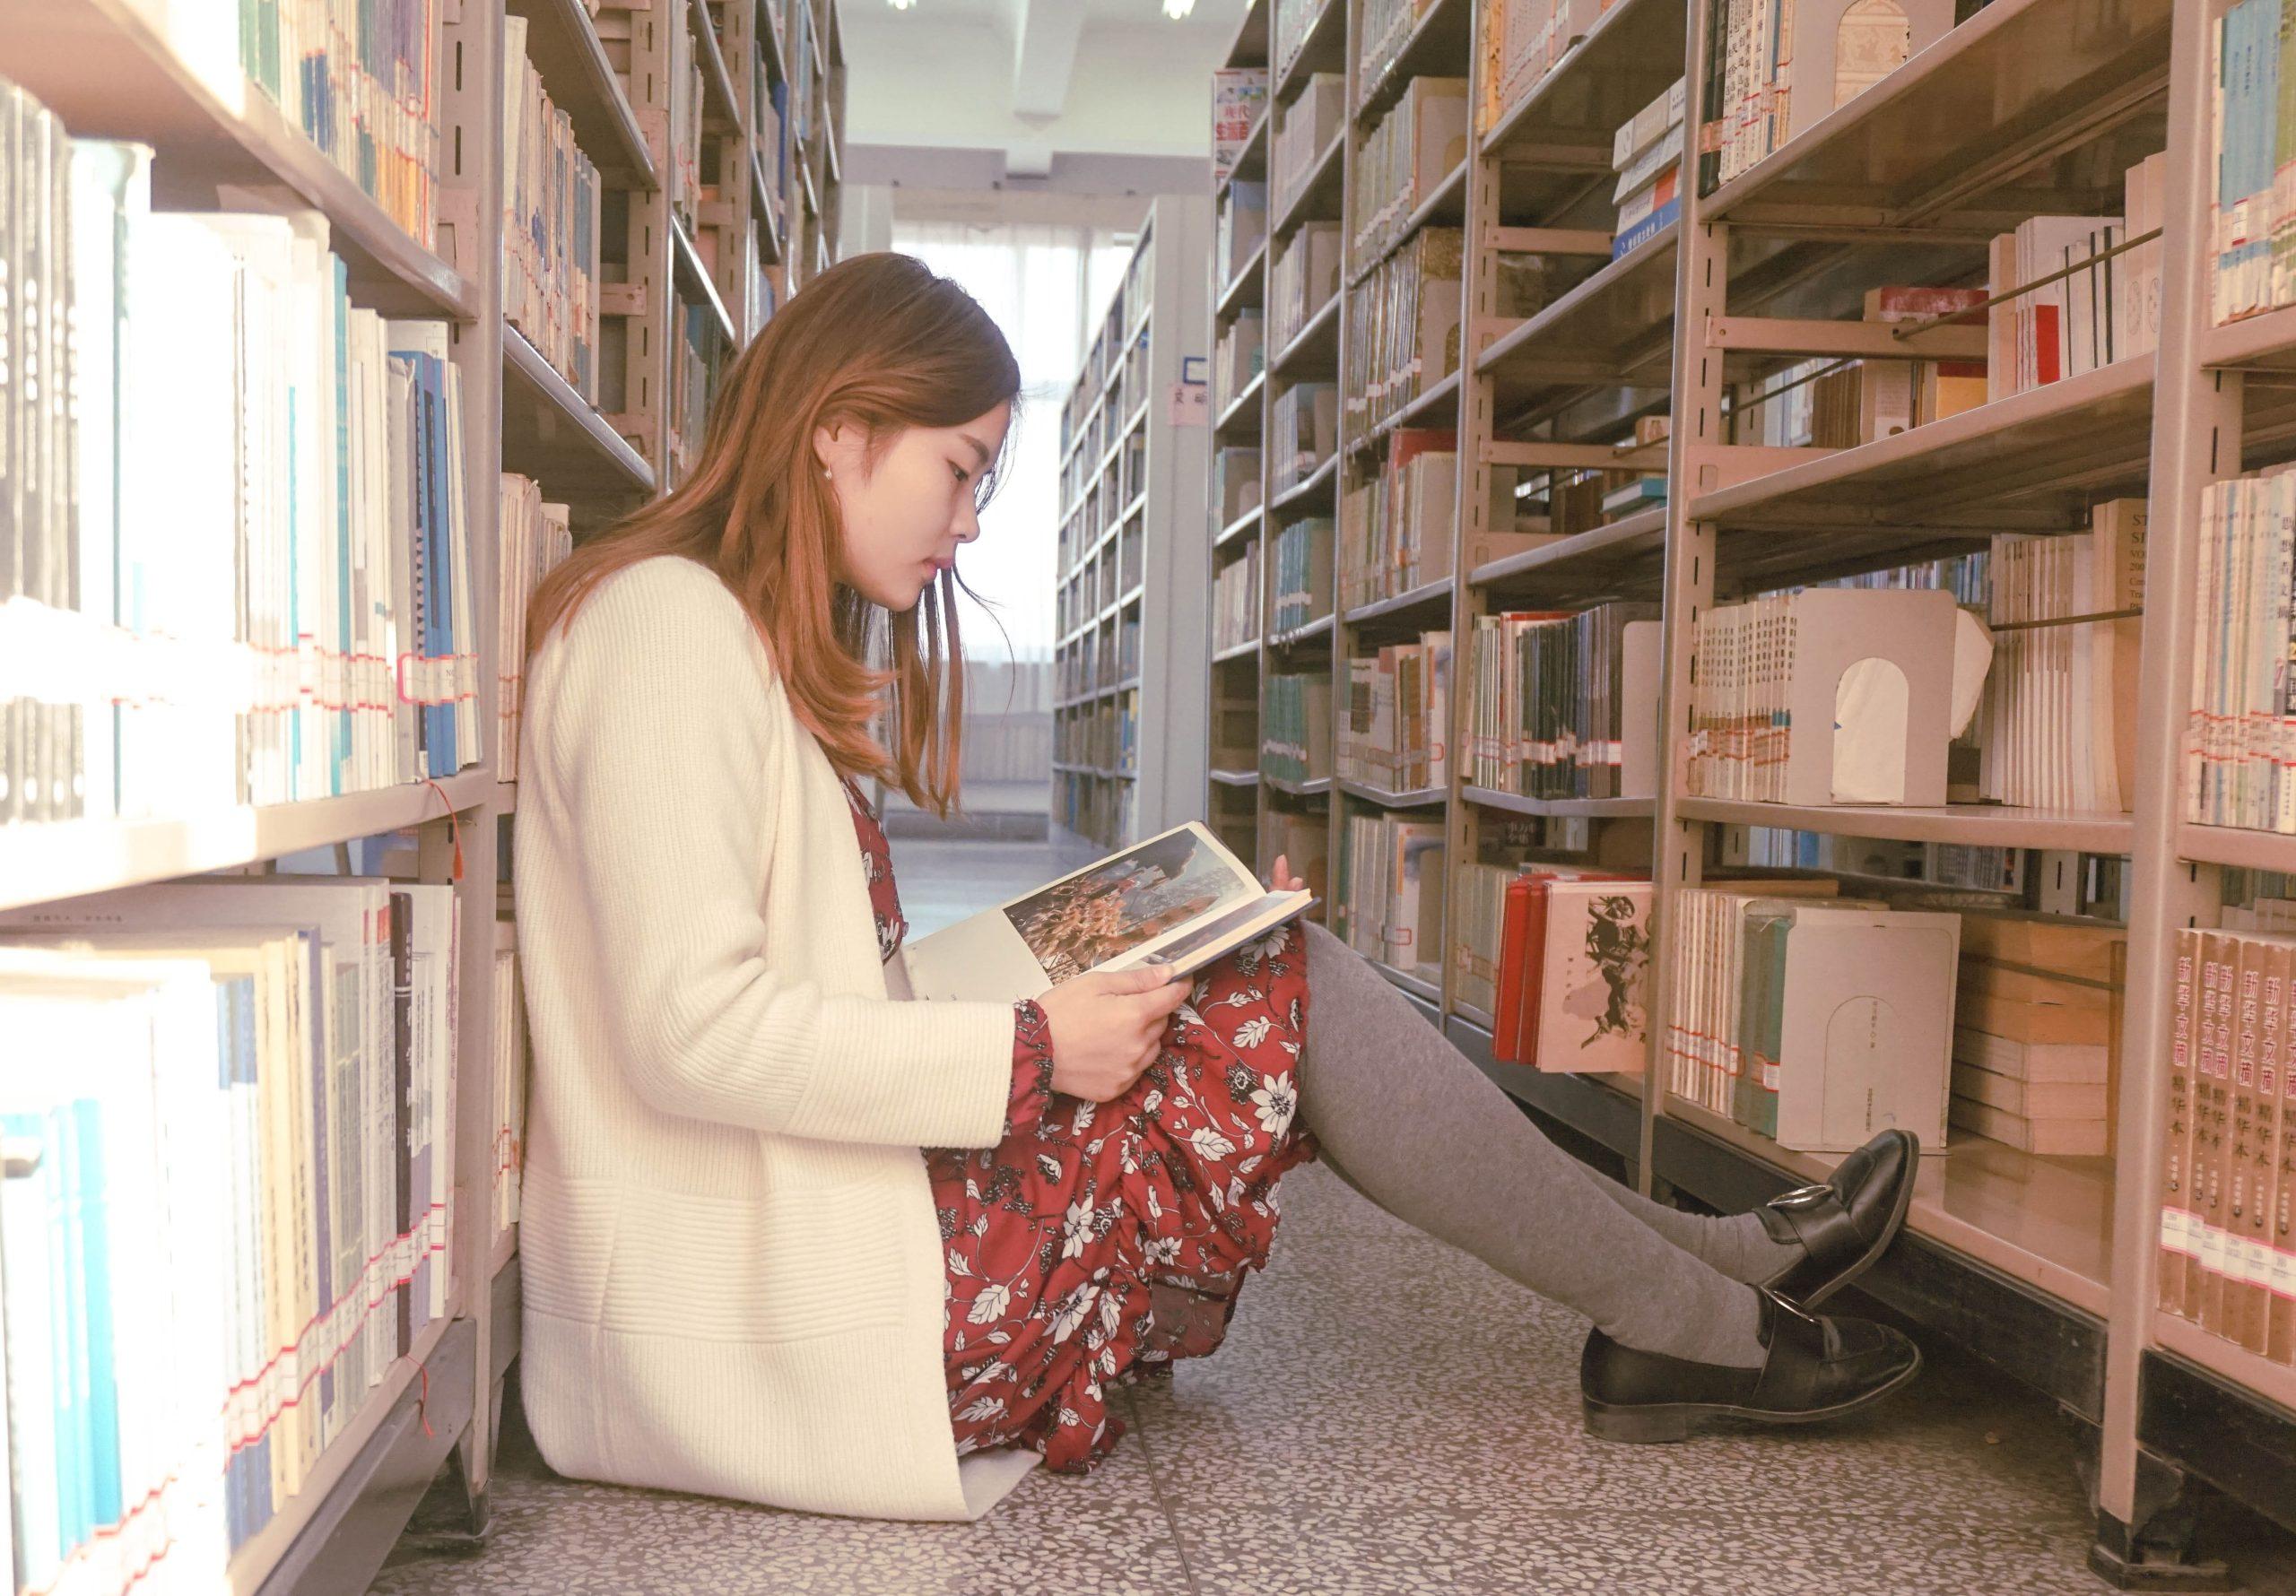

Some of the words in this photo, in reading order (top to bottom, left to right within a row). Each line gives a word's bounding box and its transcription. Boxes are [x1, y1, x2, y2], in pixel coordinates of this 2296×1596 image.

[2173, 956, 2191, 1067] 新华文摘
[2200, 962, 2218, 1074] 新华文摘
[2215, 965, 2233, 1079] 新华文摘
[2239, 970, 2259, 1087] 新华文摘
[2259, 976, 2281, 1095] 新华文摘
